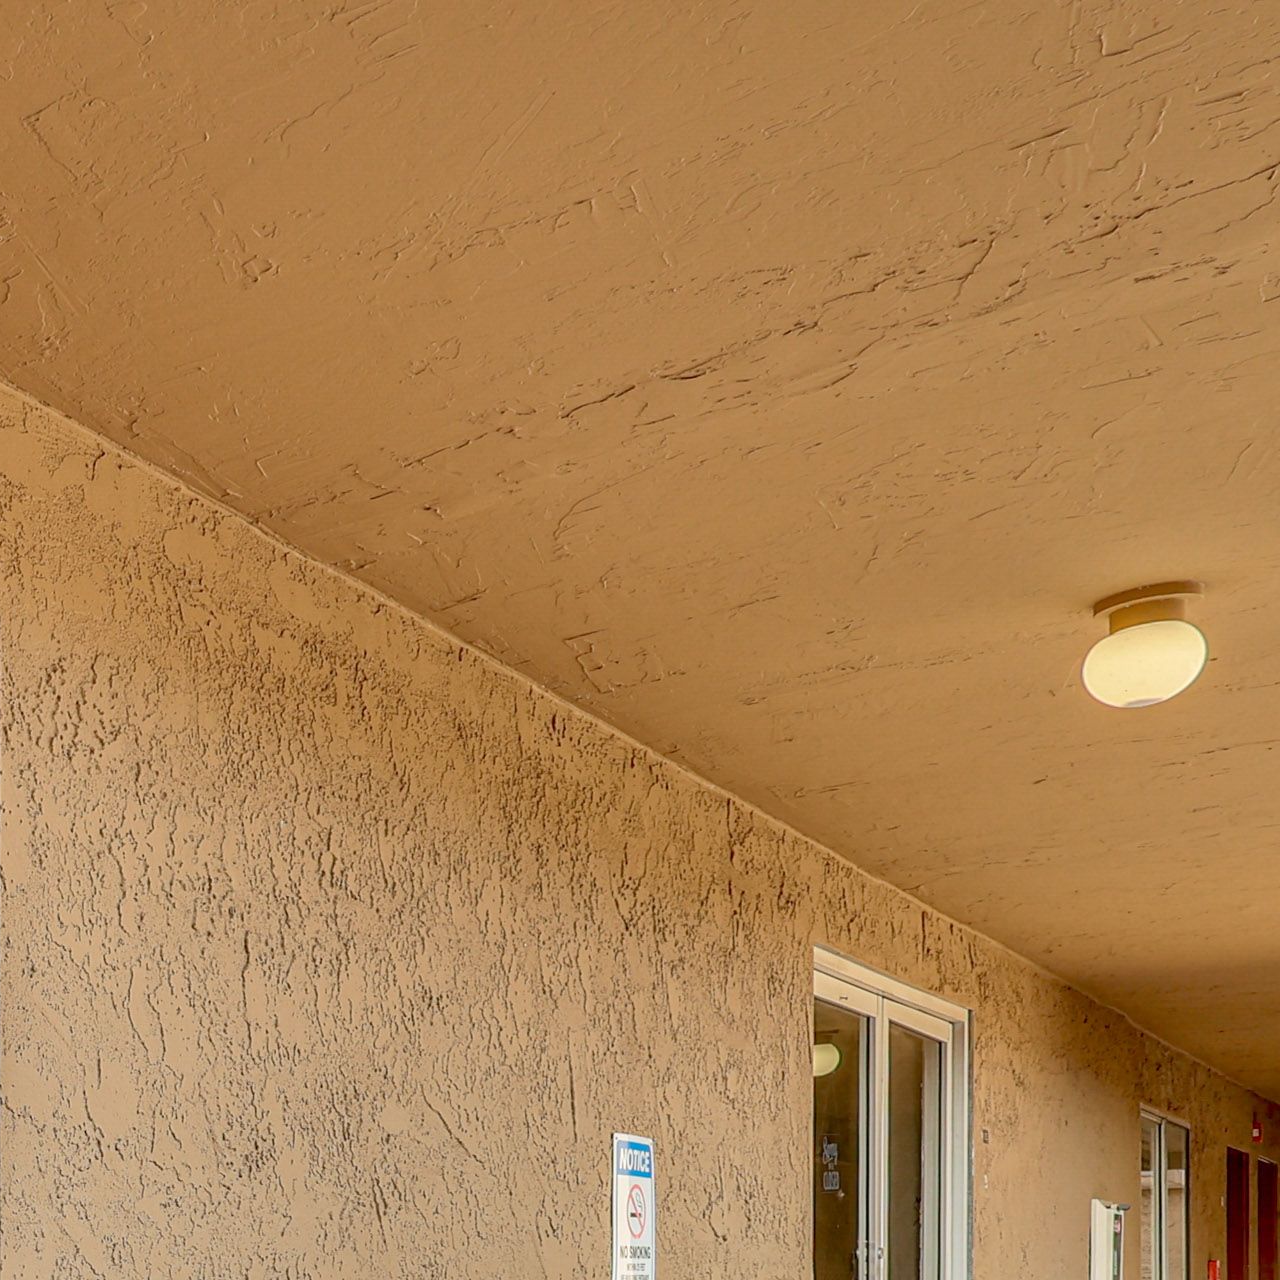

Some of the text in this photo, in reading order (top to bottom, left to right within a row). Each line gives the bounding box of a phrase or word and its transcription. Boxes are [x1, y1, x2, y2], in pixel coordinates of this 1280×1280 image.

[620, 1148, 650, 1172] NOTICE
[620, 1246, 651, 1259] NO SMOKING
